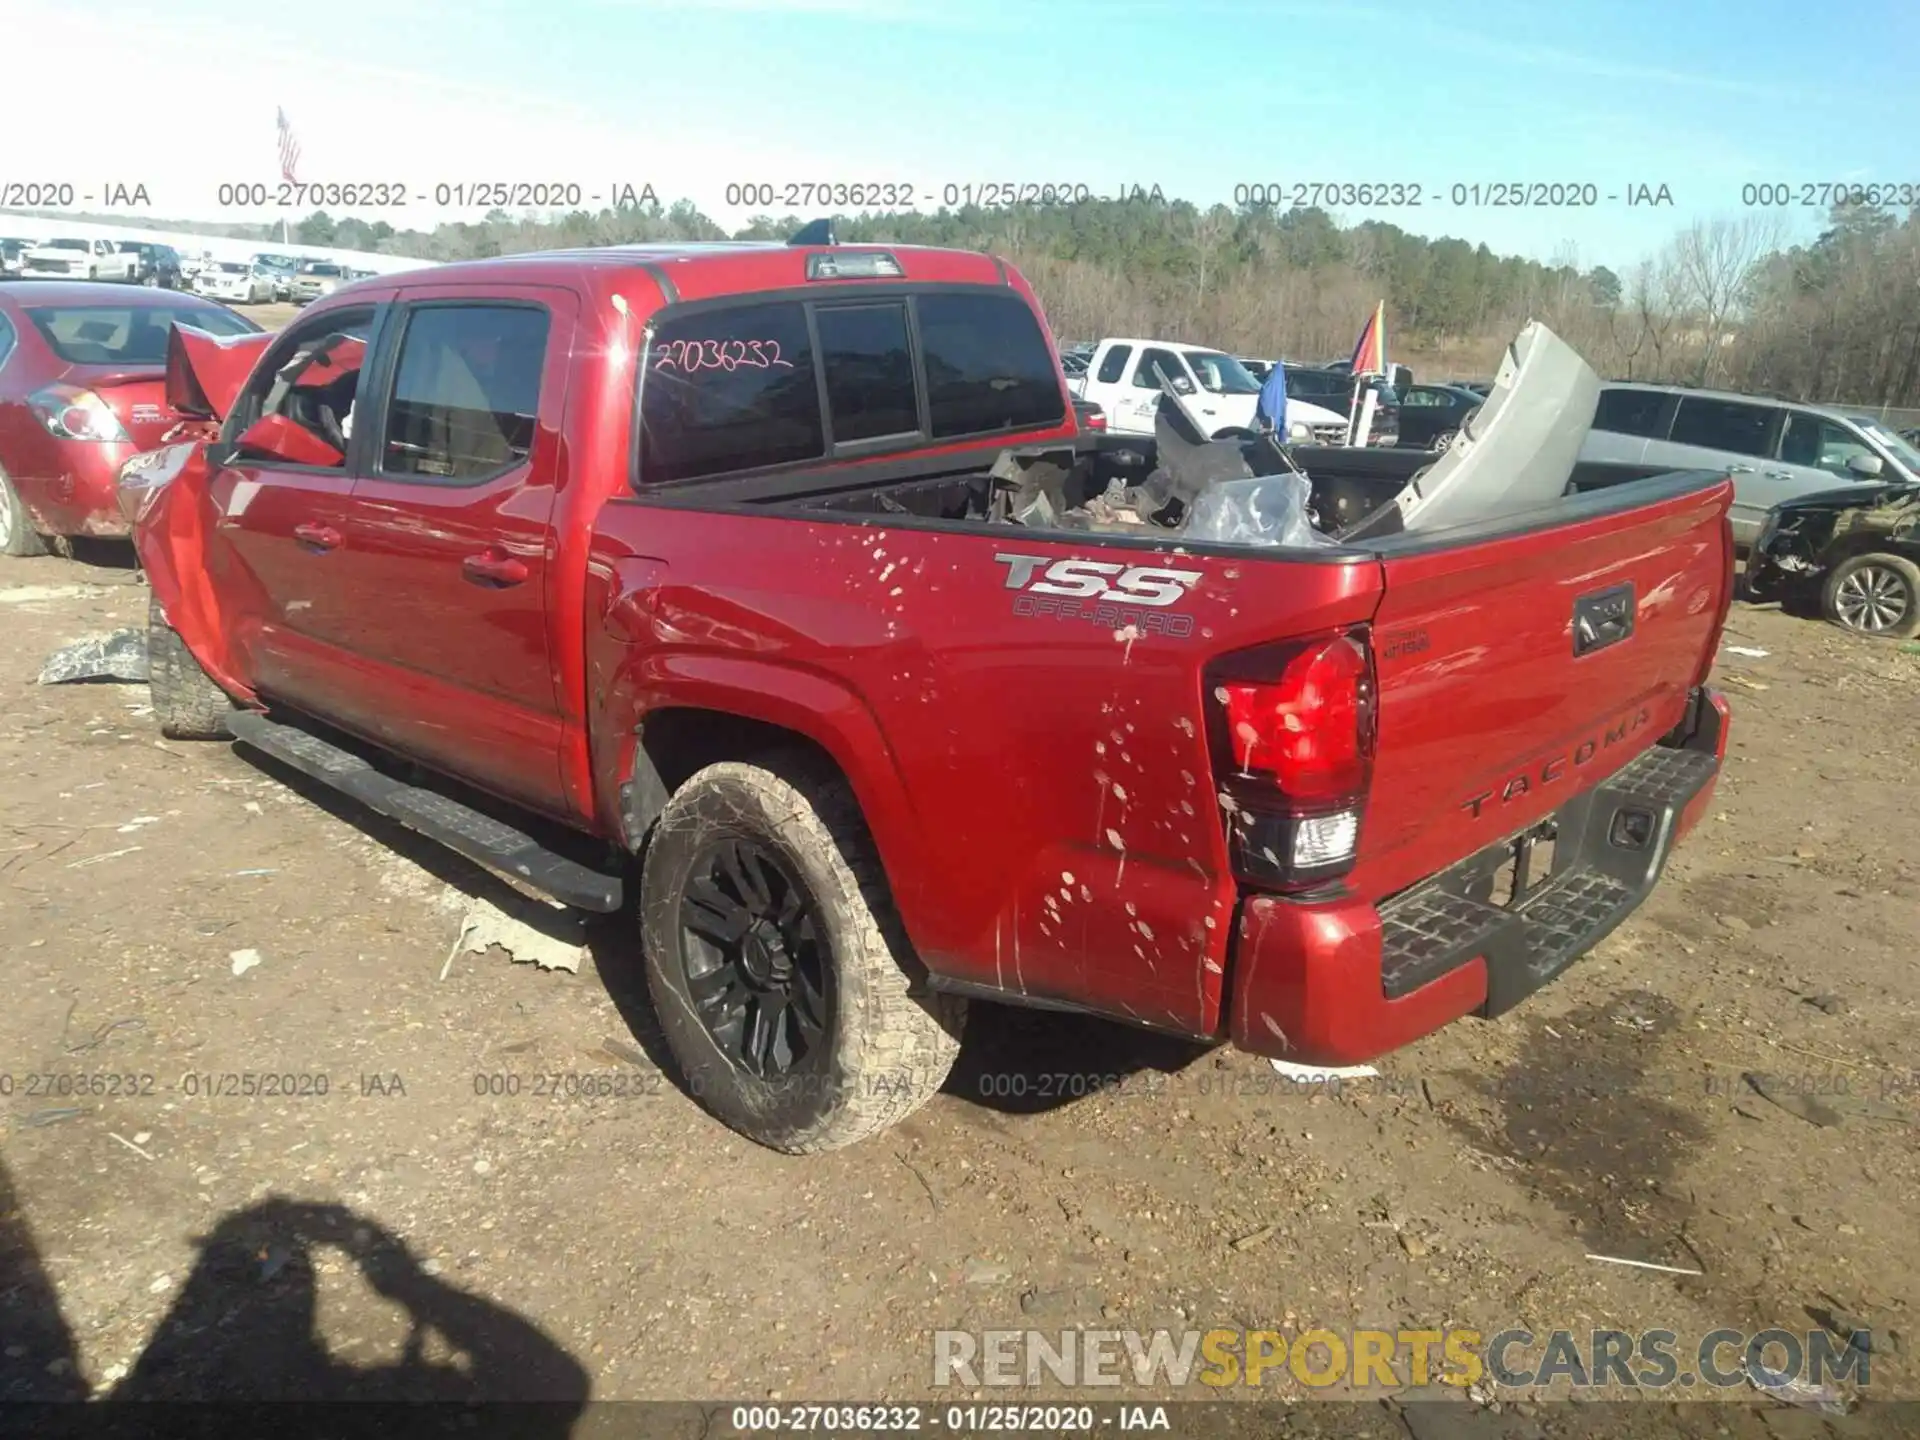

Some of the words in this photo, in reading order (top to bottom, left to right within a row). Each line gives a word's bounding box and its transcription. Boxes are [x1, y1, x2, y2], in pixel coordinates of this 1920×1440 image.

[655, 339, 794, 372] 27036232
[994, 552, 1203, 606] TSS
[1012, 595, 1195, 638] OFF-ROAD
[1460, 708, 1650, 819] TACOMA
